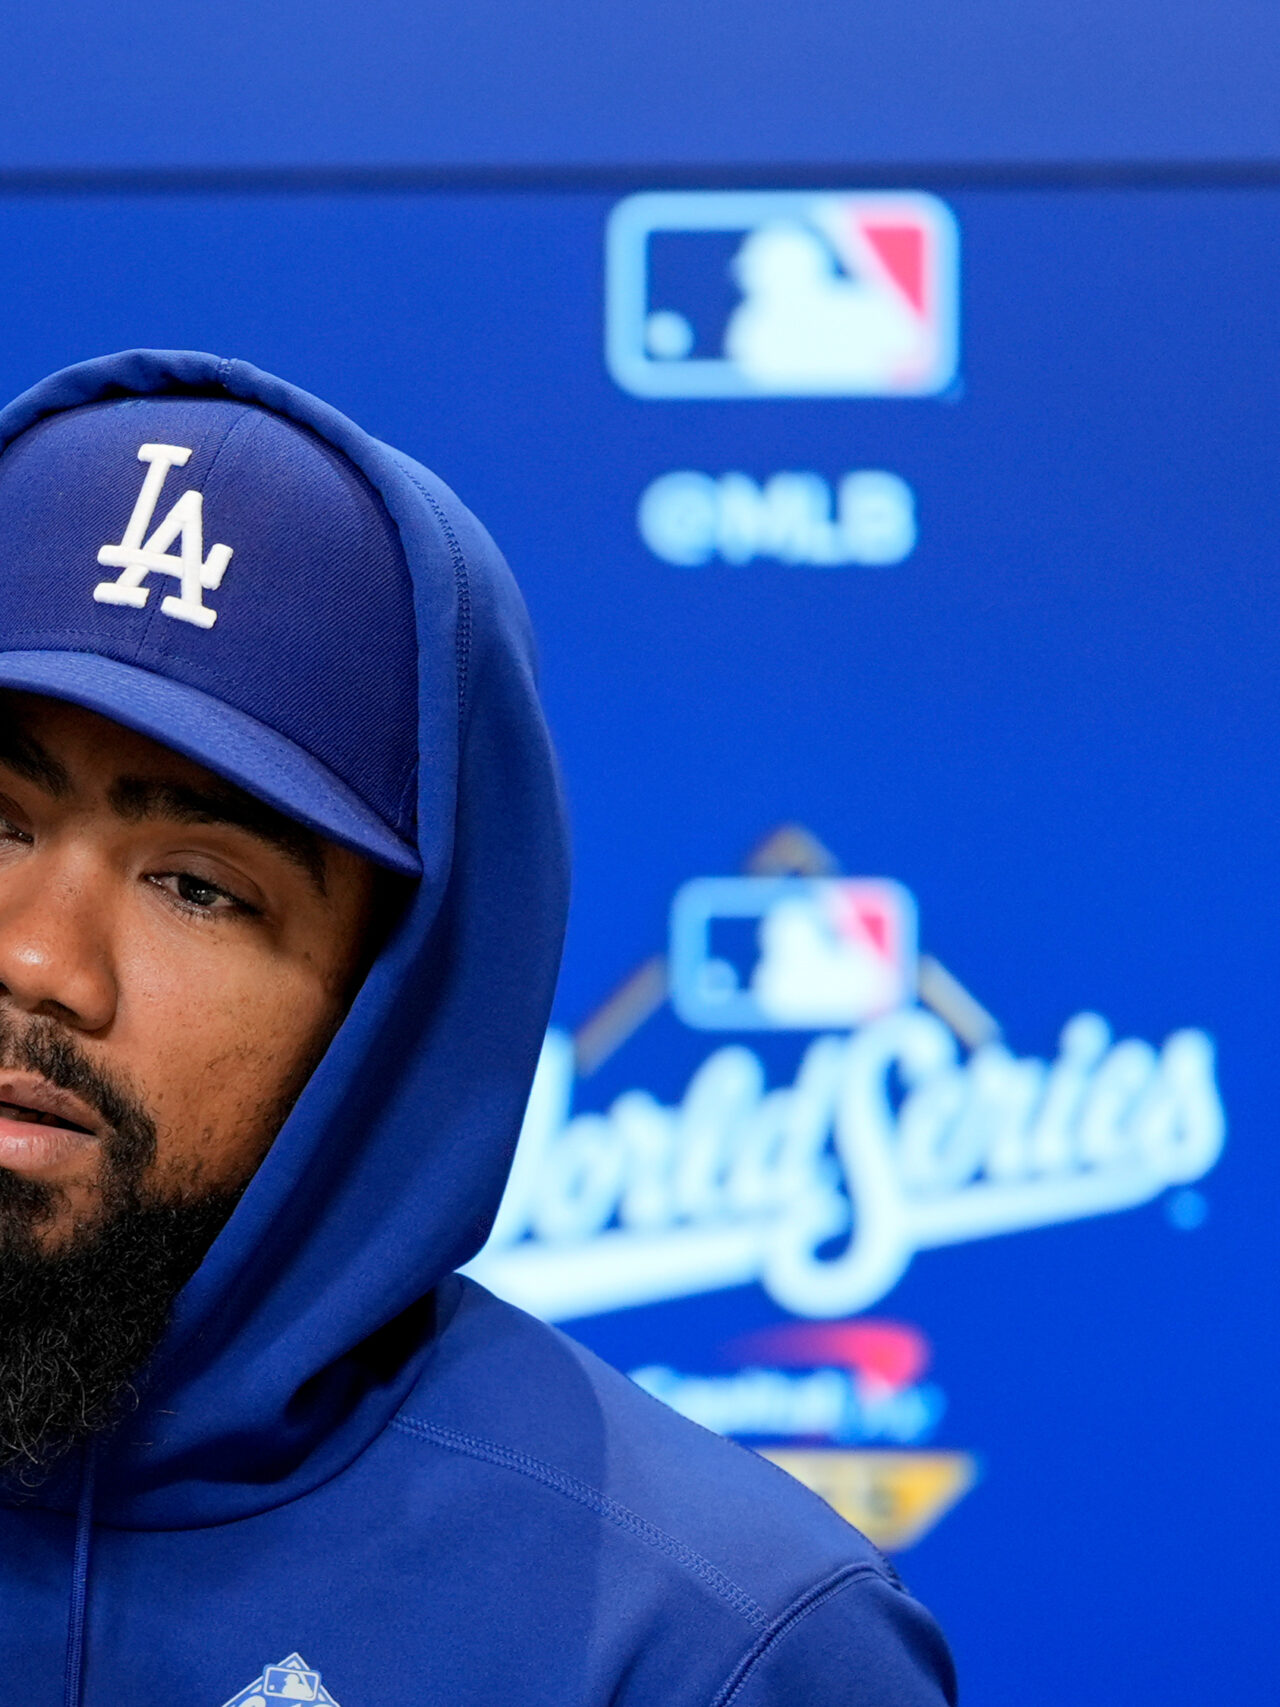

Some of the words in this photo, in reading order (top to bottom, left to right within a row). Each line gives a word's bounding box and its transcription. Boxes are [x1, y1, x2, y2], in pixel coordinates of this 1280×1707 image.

[93, 443, 234, 629] LA
[637, 470, 917, 567] @MLB
[760, 1005, 1226, 1320] Series
